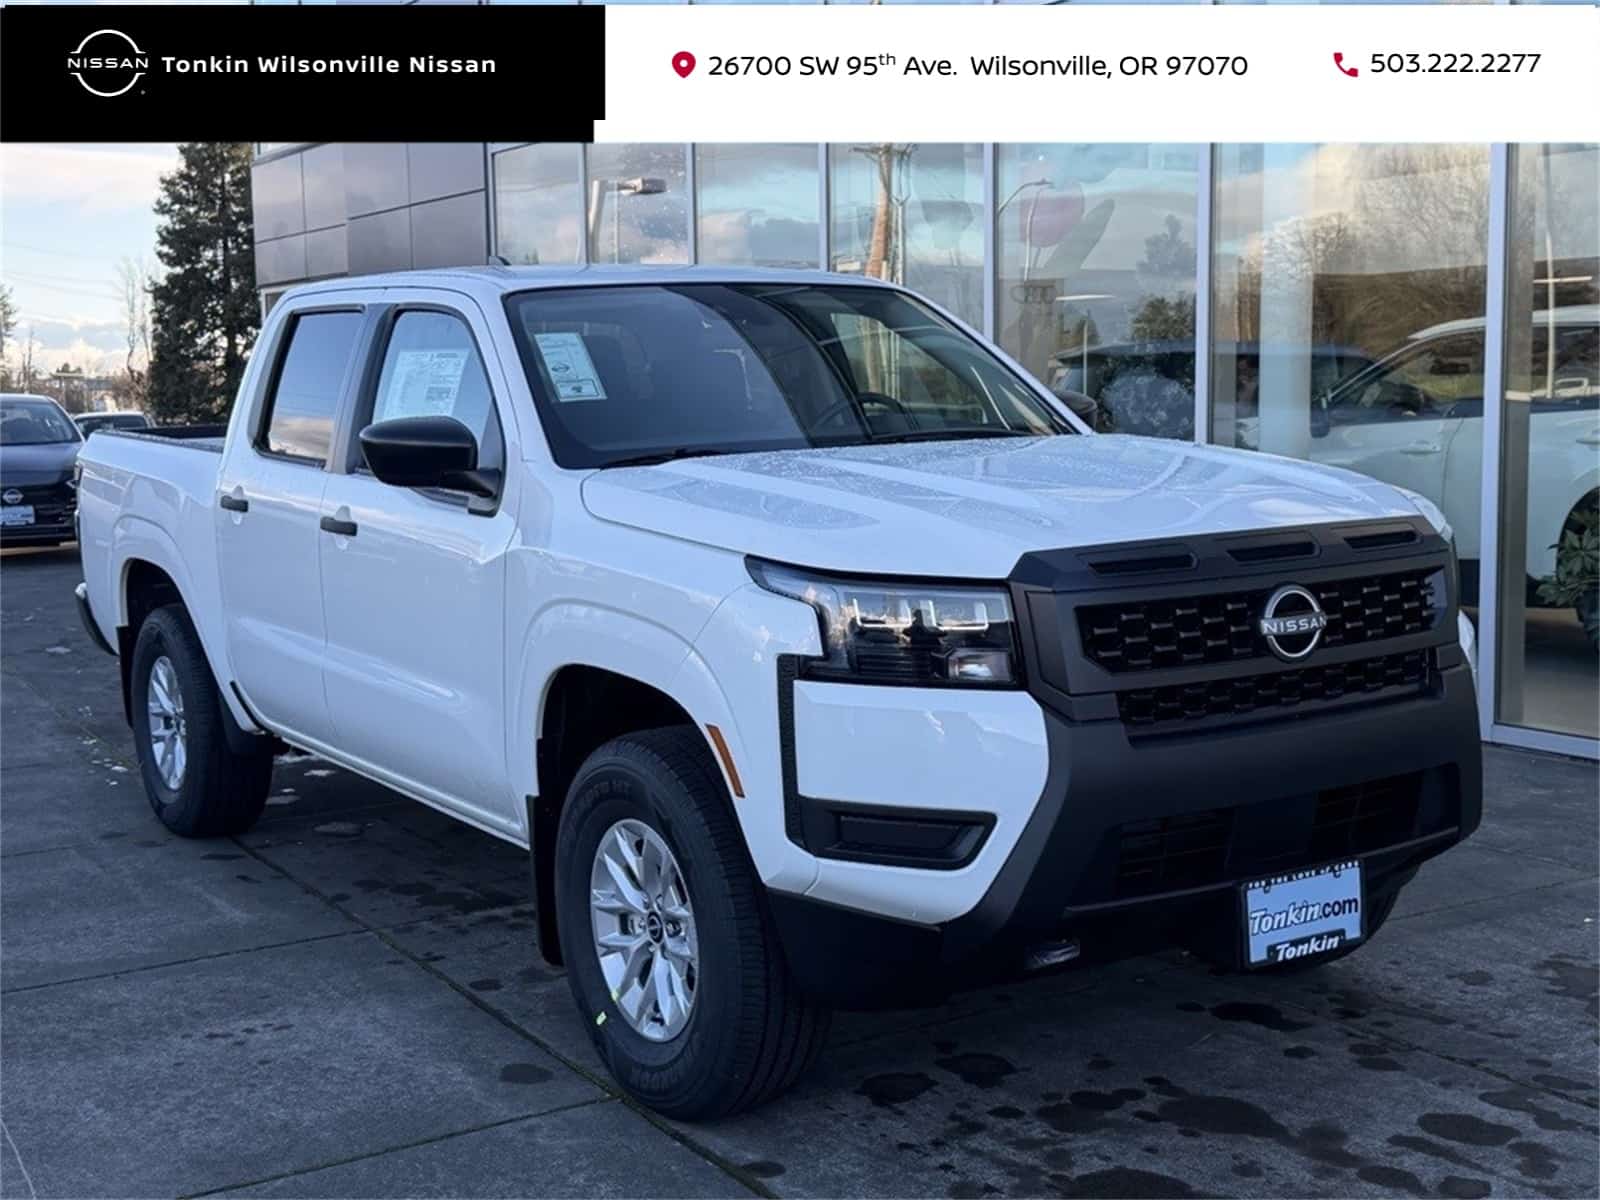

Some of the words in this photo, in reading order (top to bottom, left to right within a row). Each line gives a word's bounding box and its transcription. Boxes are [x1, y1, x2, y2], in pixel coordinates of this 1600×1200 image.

[1263, 615, 1327, 634] NISSAN
[1250, 898, 1359, 936] Tonkin.com
[1276, 934, 1341, 962] Tonkin
